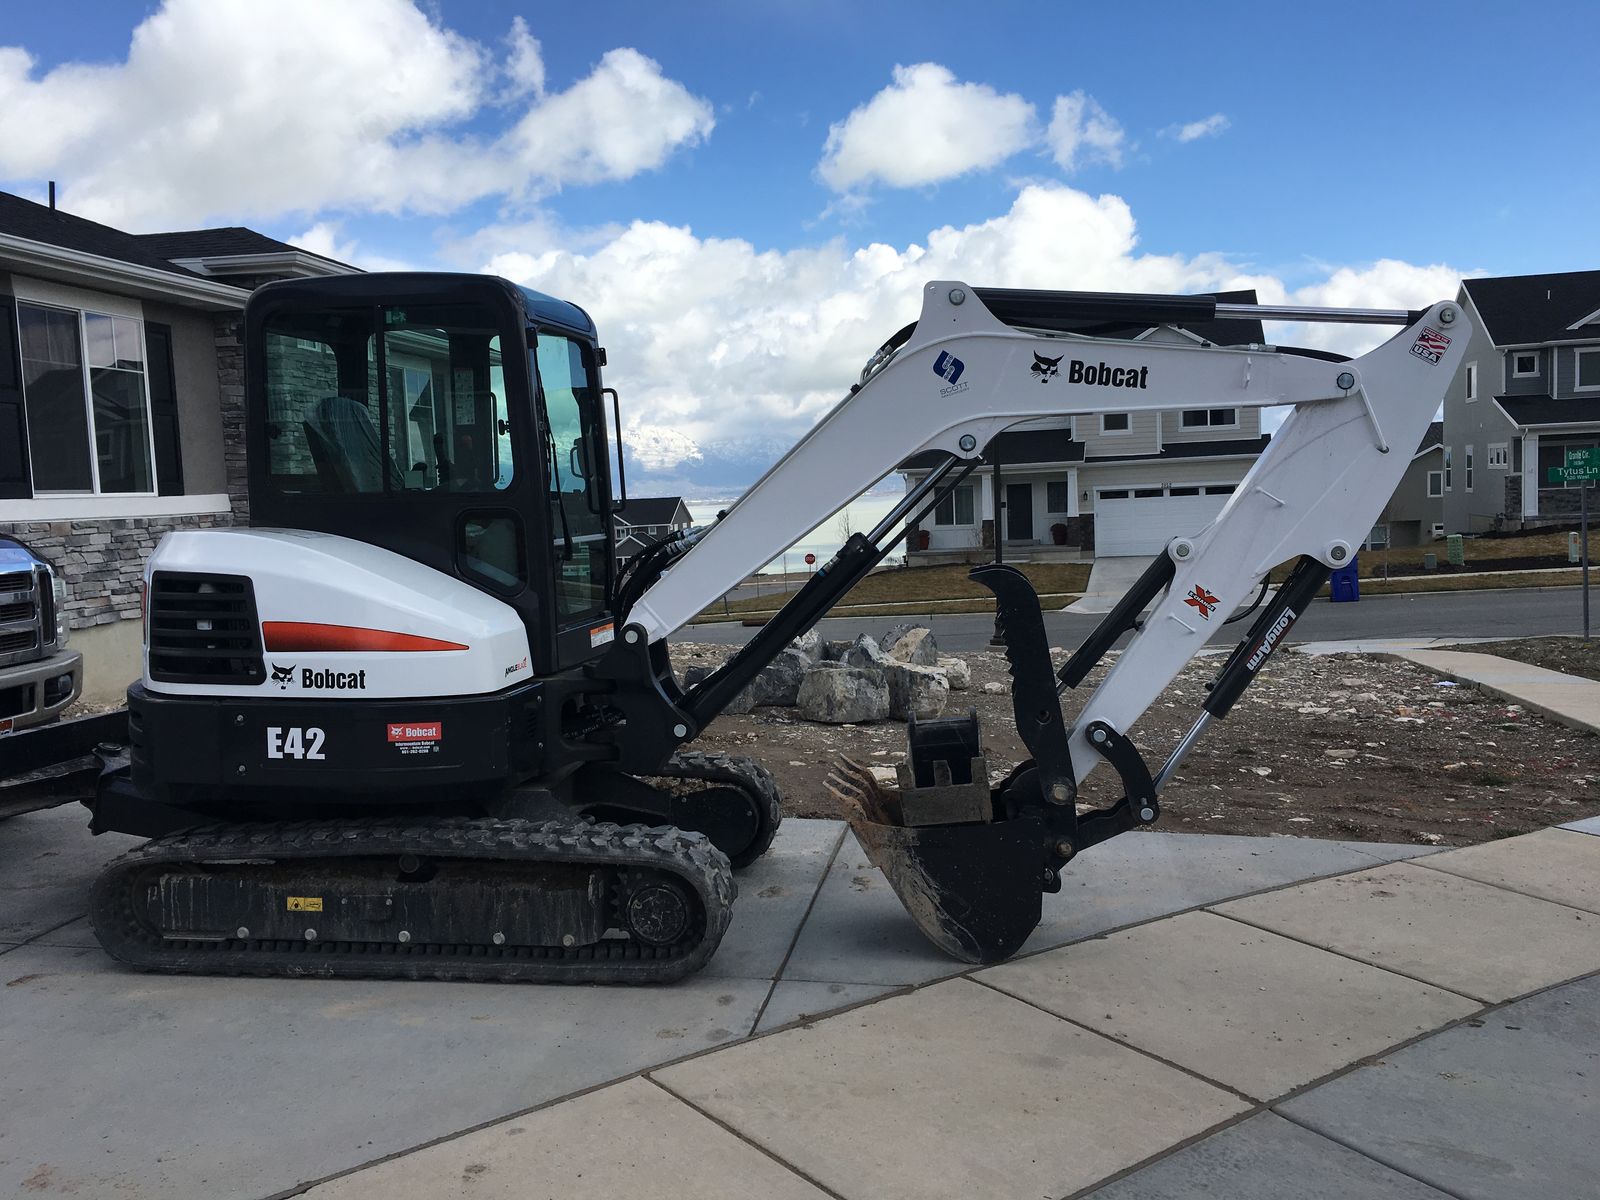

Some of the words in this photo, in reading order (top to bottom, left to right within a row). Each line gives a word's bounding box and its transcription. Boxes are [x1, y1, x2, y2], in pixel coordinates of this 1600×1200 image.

[1413, 344, 1437, 362] USA
[1068, 360, 1148, 389] Bobcat
[940, 381, 968, 395] SCOTT
[1557, 467, 1584, 478] Tytus
[1586, 466, 1598, 474] Ln
[1246, 606, 1297, 671] LongArm
[302, 668, 366, 689] Bobcat
[406, 727, 436, 737] Bobcat
[267, 727, 326, 760] E42
